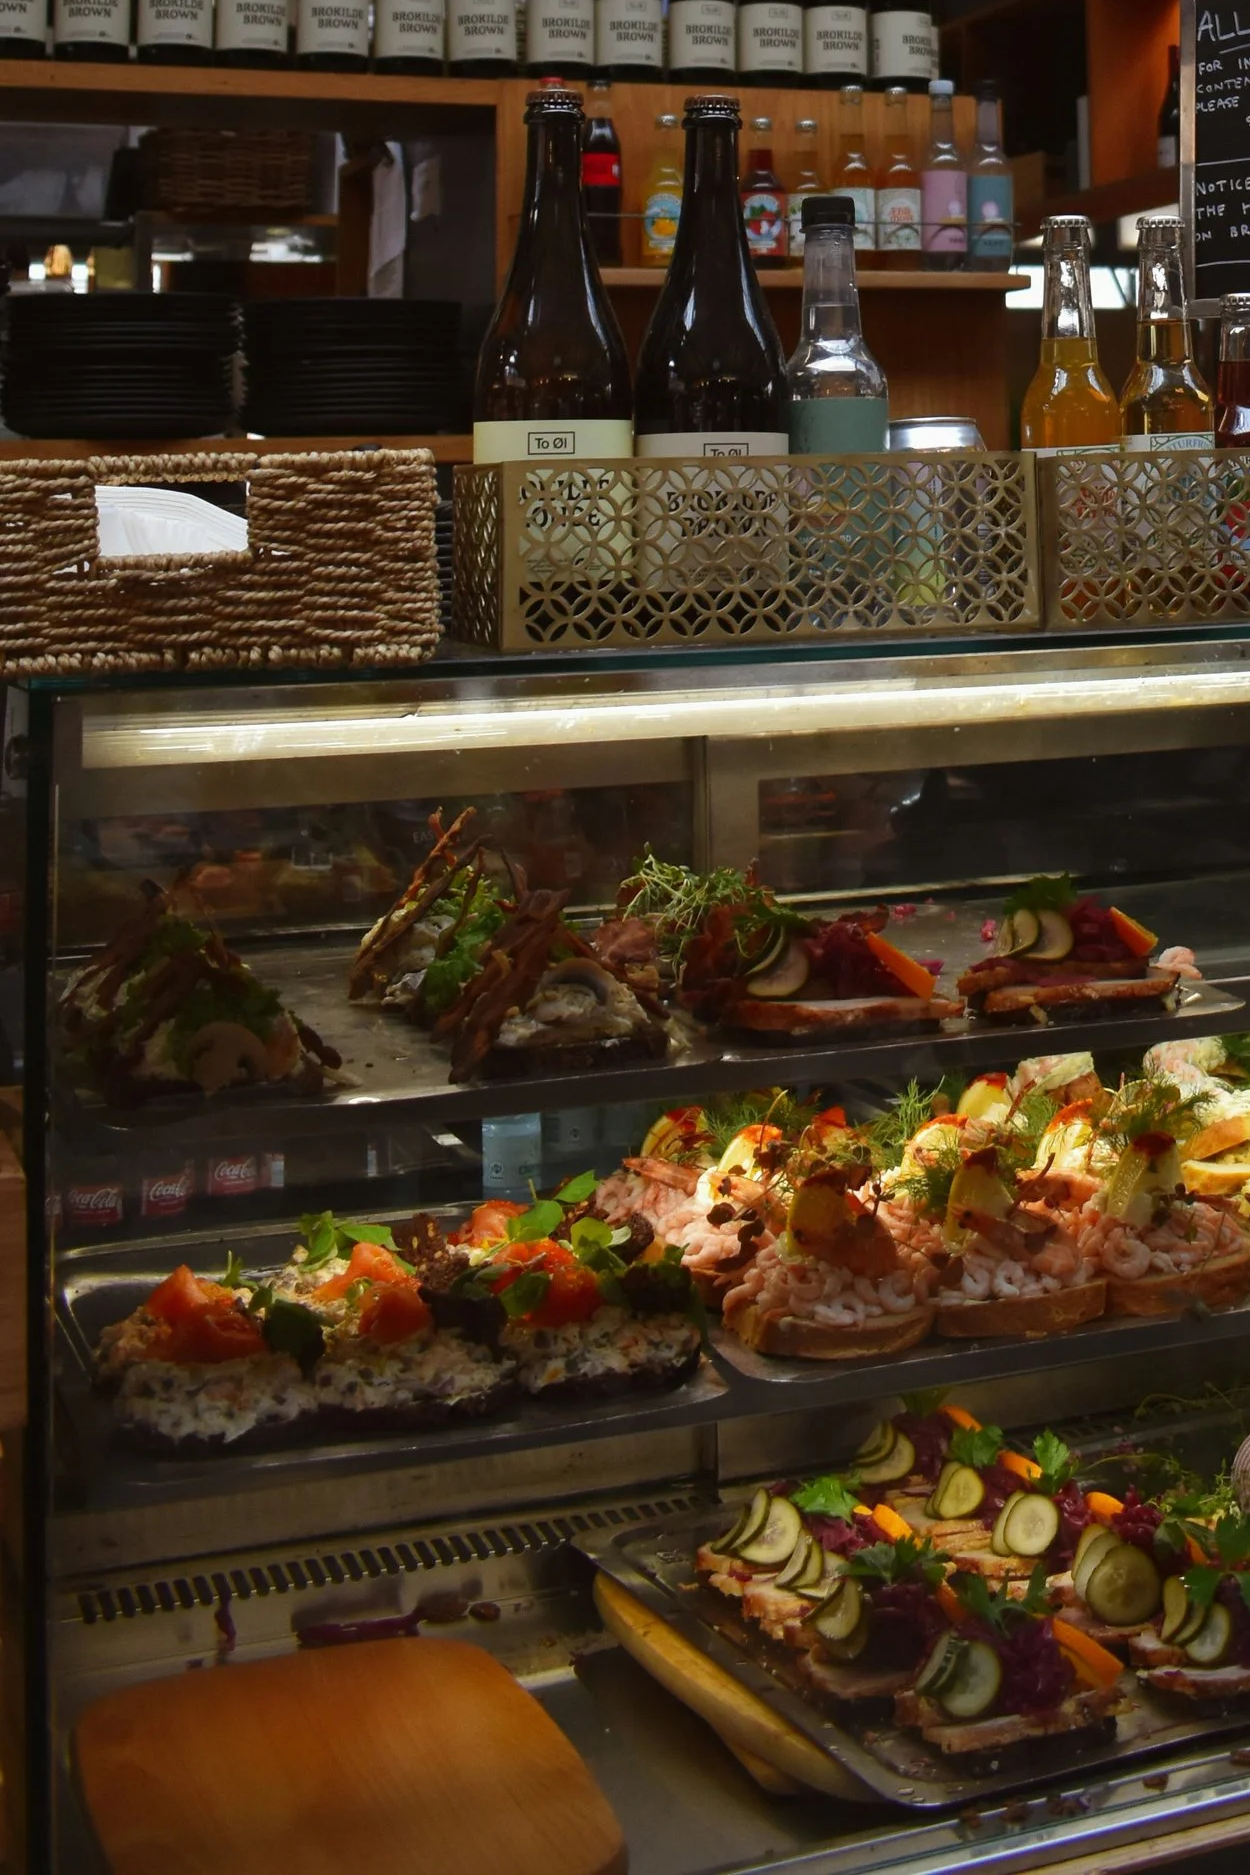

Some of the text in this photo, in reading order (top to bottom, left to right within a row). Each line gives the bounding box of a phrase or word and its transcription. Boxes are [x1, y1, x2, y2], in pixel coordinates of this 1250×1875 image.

[67, 6, 112, 19] BROWN
[154, 9, 199, 21] BROWN
[456, 13, 509, 27] BROKILDE
[463, 24, 505, 37] BROWN
[815, 29, 862, 43] BROKILDE
[822, 39, 860, 52] BROWN
[1198, 59, 1223, 75] FOR
[1196, 203, 1226, 220] THE
[535, 436, 568, 451] To Øl
